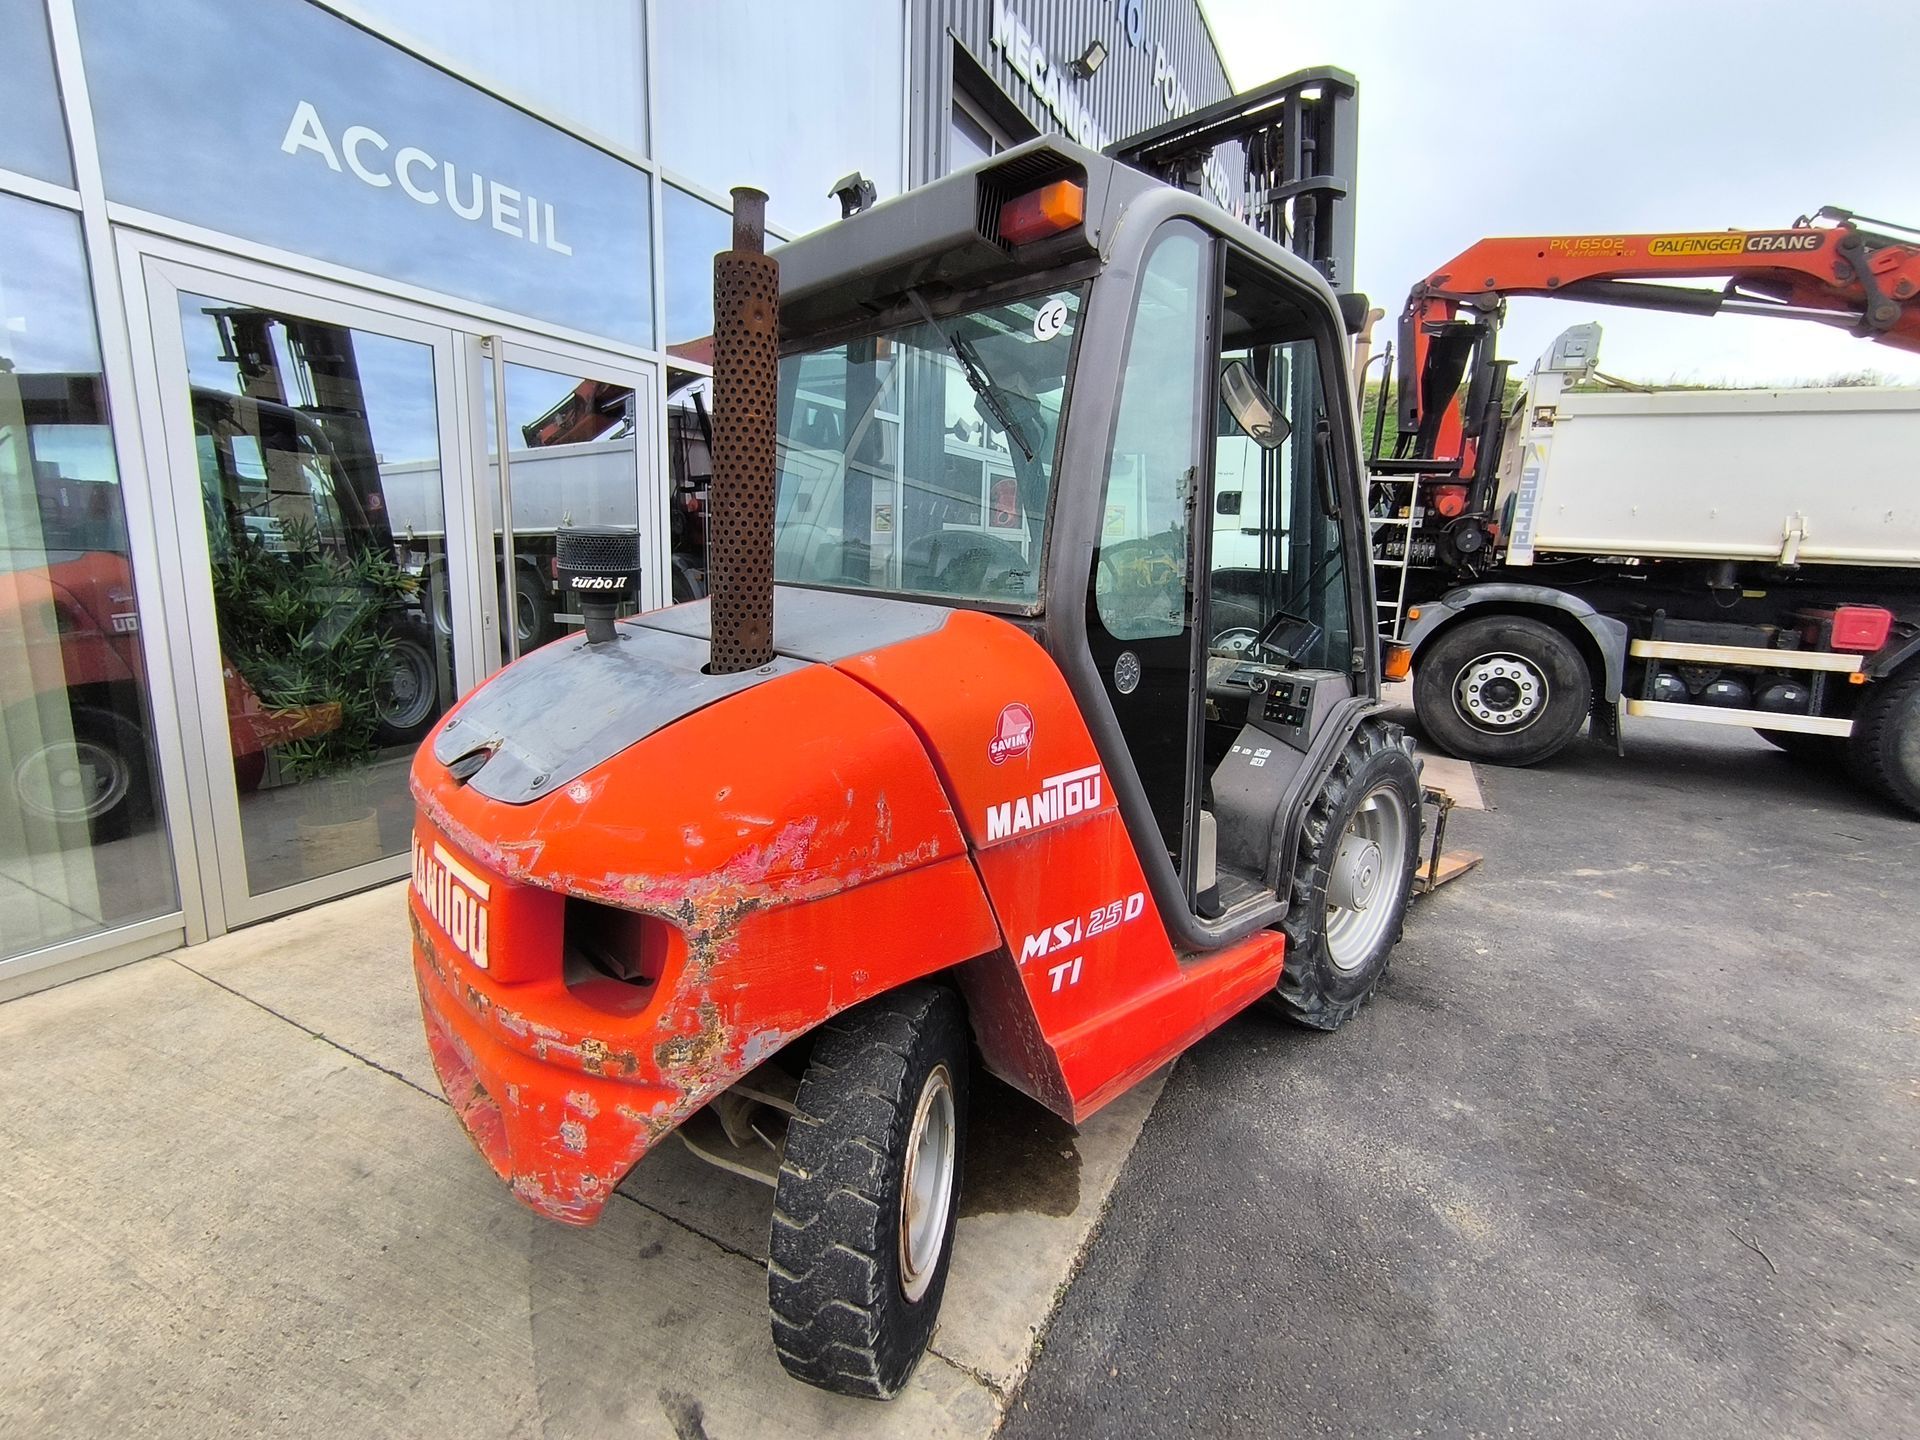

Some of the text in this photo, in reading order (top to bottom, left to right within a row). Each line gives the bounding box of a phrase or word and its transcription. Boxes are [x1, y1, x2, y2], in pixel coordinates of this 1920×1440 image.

[991, 0, 1109, 154] MECANIQU
[281, 100, 573, 257] ACCUEIL
[1549, 238, 1625, 250] PK 16502
[1565, 249, 1636, 257] Performance
[1653, 235, 1817, 252] PALFINGER CRANE
[1038, 307, 1063, 332] CE
[1511, 467, 1540, 549] marrel
[572, 577, 613, 588] turbo
[990, 734, 1027, 753] SAVIM
[987, 765, 1101, 841] MANITOU
[1019, 917, 1082, 965] MSI
[1047, 956, 1084, 993] TI
